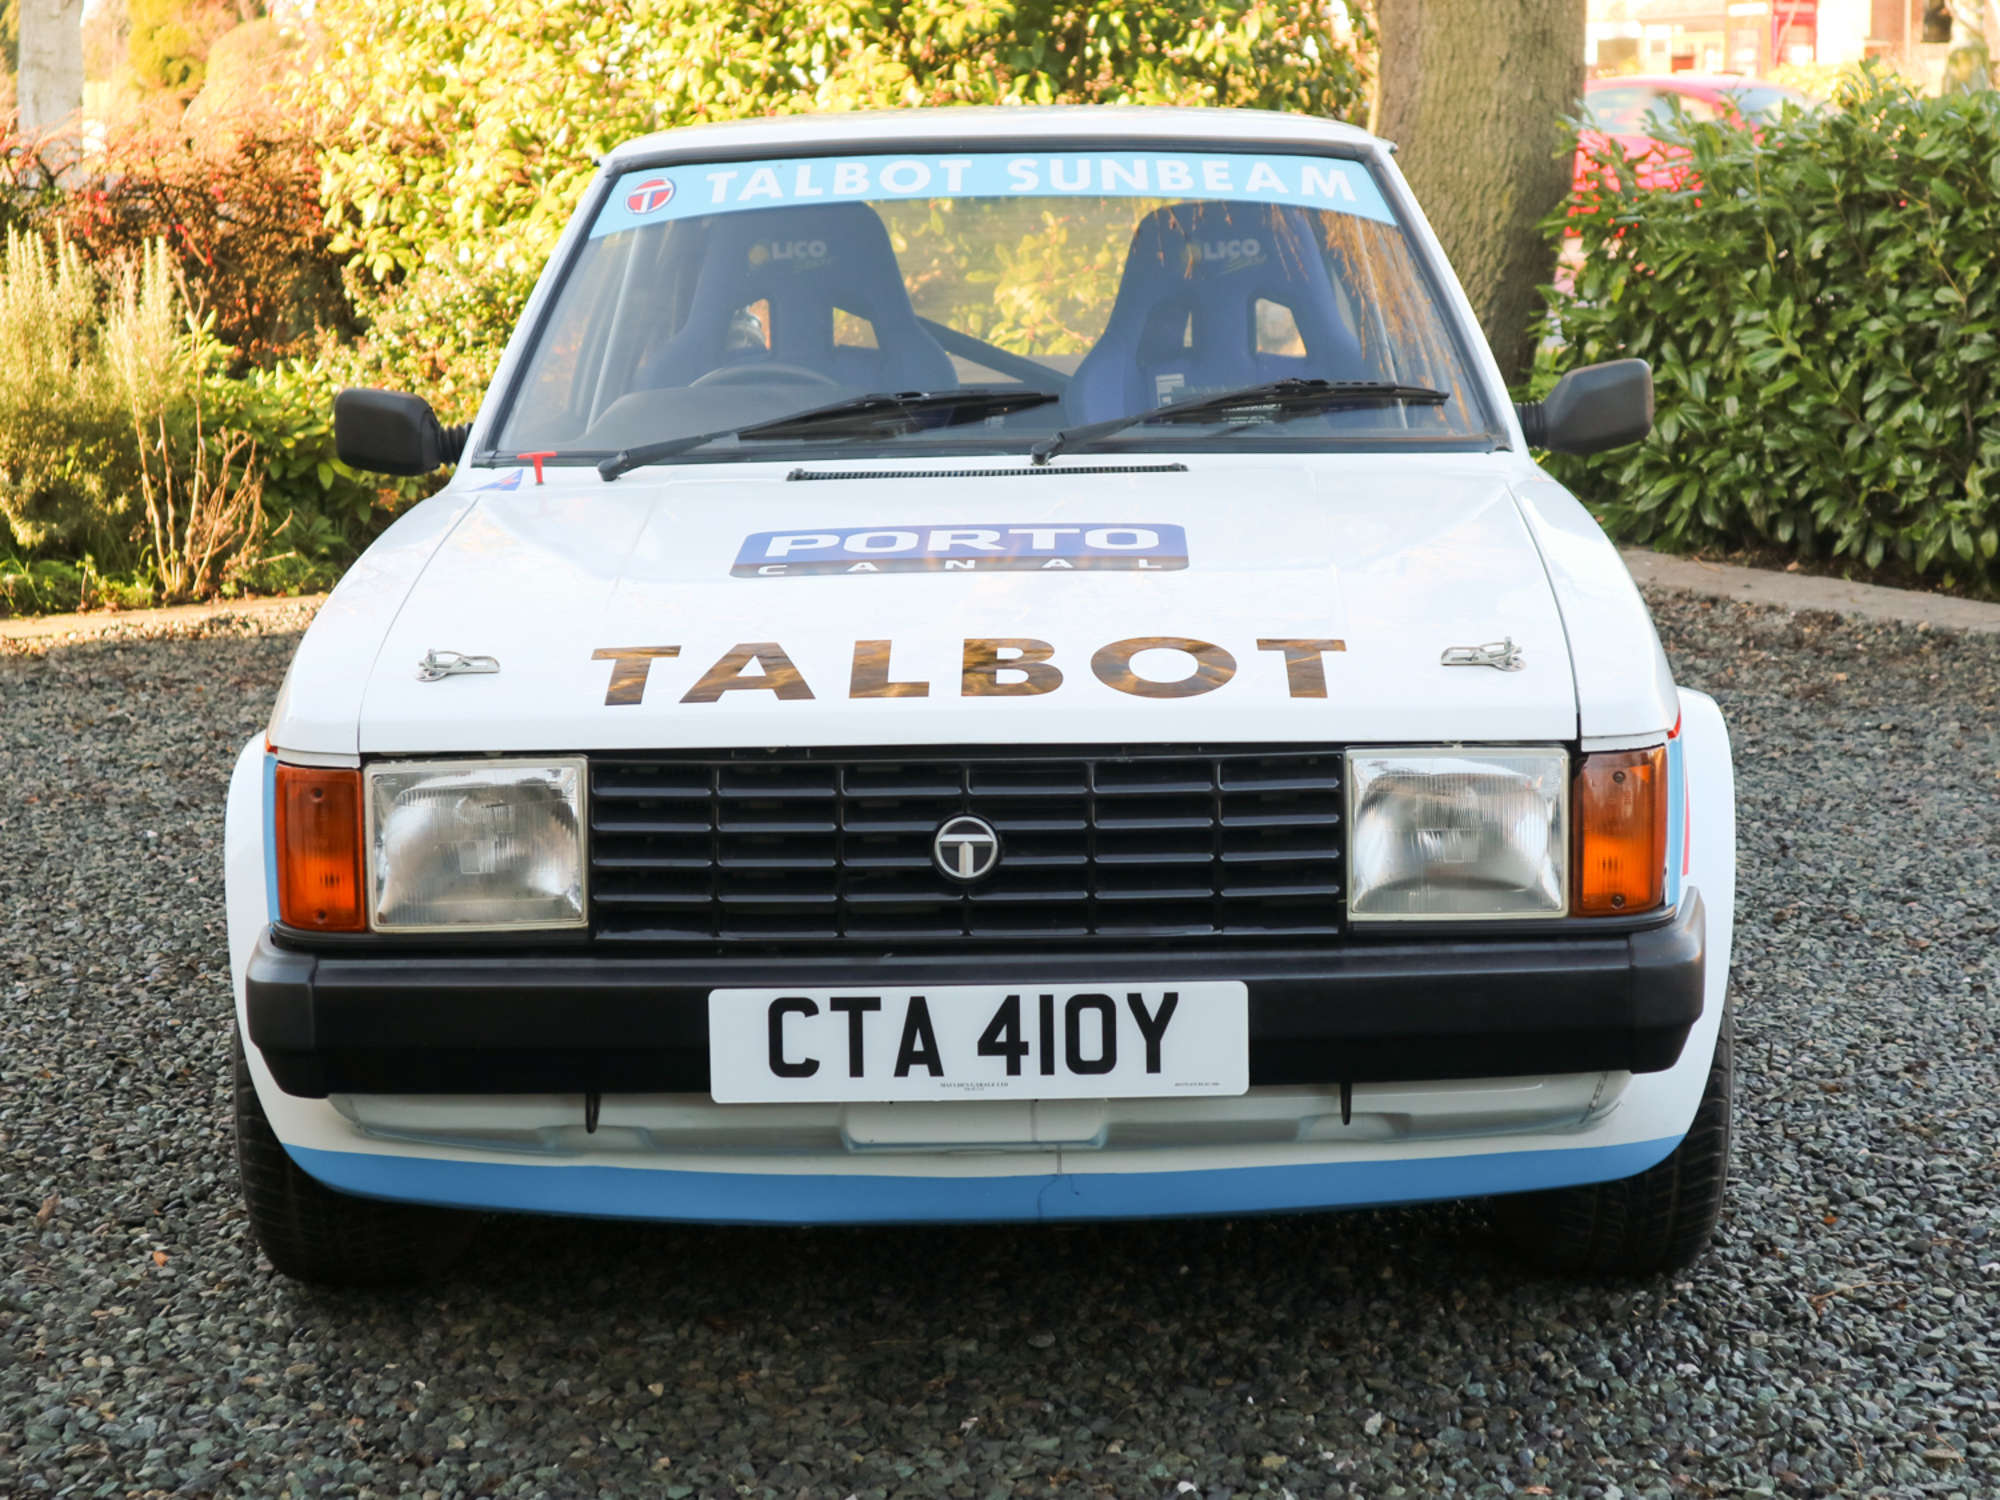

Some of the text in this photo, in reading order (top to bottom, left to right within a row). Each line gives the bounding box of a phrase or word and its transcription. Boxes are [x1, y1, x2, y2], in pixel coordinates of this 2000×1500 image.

[706, 156, 1358, 205] TALBOT SUNBEAM
[771, 239, 827, 260] LICO
[765, 526, 1161, 558] PORTO
[757, 558, 1162, 576] CANAL
[591, 636, 1347, 706] TALBOT
[768, 992, 1179, 1078] CTA 410Y
